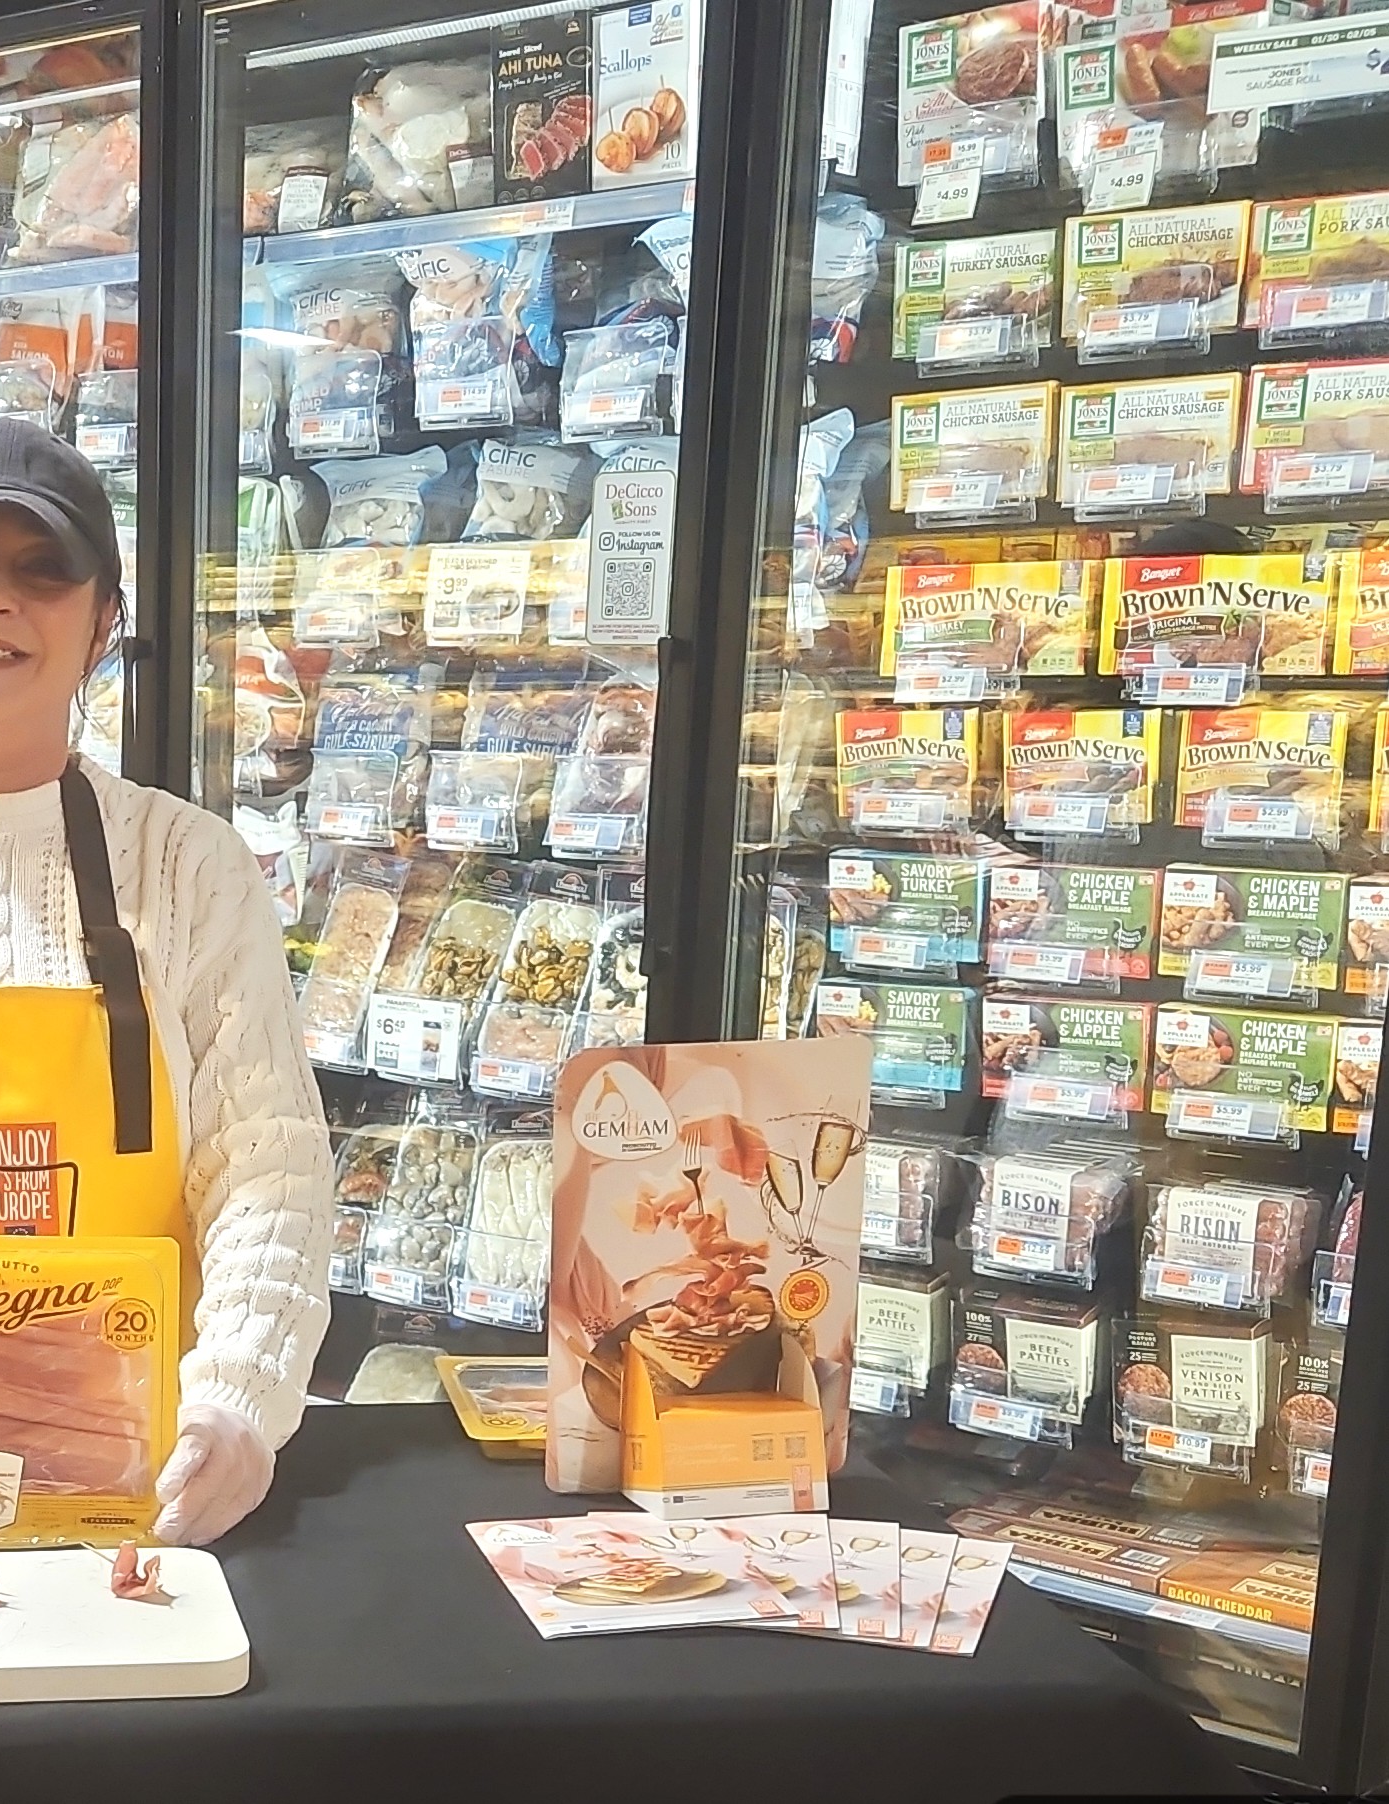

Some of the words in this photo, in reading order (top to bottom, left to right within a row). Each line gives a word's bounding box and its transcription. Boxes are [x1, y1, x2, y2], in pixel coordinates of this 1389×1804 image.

[914, 43, 949, 60] JONES
[1233, 42, 1273, 54] WEEKLY
[1274, 38, 1299, 49] SALE
[498, 61, 522, 77] AHI
[525, 53, 563, 73] TUNA
[600, 50, 652, 75] Scallops
[1071, 65, 1107, 82] JONES
[1269, 67, 1301, 79] JONES
[1246, 78, 1293, 92] SAUSAGE
[1296, 75, 1321, 85] ROLL
[665, 142, 681, 159] 10
[1111, 174, 1144, 188] $4.99
[937, 188, 969, 200] $4.99
[1321, 209, 1347, 221] ALL
[1129, 224, 1151, 236] ALL
[1155, 218, 1214, 233] NATURAL
[1272, 220, 1307, 233] JONES
[1318, 220, 1360, 235] PORK
[1085, 233, 1116, 247] JONES
[1128, 233, 1179, 249] CHICKEN
[1182, 228, 1234, 243] SAUSAGE
[975, 244, 1029, 259] NATURAL
[911, 258, 941, 270] JONES
[950, 259, 993, 273] TURKEY
[995, 253, 1048, 269] SAUSAGE
[1123, 313, 1150, 323] $3.79
[1316, 378, 1340, 391] ALL
[1122, 396, 1143, 408] ALL
[1147, 391, 1202, 406] NATURAL
[1266, 388, 1300, 401] JONES
[1314, 390, 1352, 403] PORK
[946, 405, 966, 417] ALL
[968, 400, 1018, 414] NATURAL
[1077, 407, 1108, 419] JONES
[1118, 405, 1169, 420] CHICKEN
[1172, 401, 1225, 415] SAUSAGE
[906, 416, 934, 428] JONES
[943, 413, 989, 428] CHICKEN
[992, 410, 1040, 423] SAUSAGE
[1314, 464, 1342, 474] $3.79
[606, 482, 663, 501] DeCicco
[625, 502, 657, 517] Sons
[616, 539, 664, 555] Instagram
[1140, 566, 1184, 583] Banquet
[1003, 587, 1069, 619] Serve
[1238, 582, 1310, 615] Serve
[1147, 616, 1200, 632] ORIGINAL
[1193, 676, 1220, 685] $2.99
[500, 723, 525, 737] WILD
[917, 738, 965, 761] Serve
[1091, 739, 1145, 764] Serve
[1274, 741, 1331, 767] Serve
[1261, 809, 1289, 817] $2.99
[901, 863, 953, 880] SAVORY
[901, 877, 955, 894] TURKEY
[995, 885, 1033, 893] APPLEGATE
[1070, 871, 1135, 892] CHICKEN
[1250, 877, 1321, 897] CHICKEN
[1068, 891, 1078, 904] &
[1084, 891, 1129, 906] APPLE
[1248, 898, 1258, 911] &
[1262, 897, 1319, 913] MAPLE
[1247, 909, 1284, 918] BREAKFAST
[1286, 911, 1317, 921] SAUSAGE
[1235, 963, 1262, 974] $5.99
[888, 990, 941, 1007] SAVORY
[887, 1004, 941, 1021] TURKEY
[1060, 1008, 1123, 1026] CHICKEN
[1060, 1024, 1067, 1037] &
[1071, 1024, 1120, 1040] APPLE
[1242, 1019, 1307, 1040] CHICKEN
[1240, 1039, 1251, 1052] &
[1255, 1039, 1306, 1057] MAPLE
[1240, 1051, 1277, 1061] BREAKFAST
[1216, 1107, 1243, 1116] $5.99
[583, 1119, 668, 1138] GEMHAM
[15, 1170, 50, 1192] FROM
[1000, 1188, 1061, 1215] BISON
[1177, 1198, 1209, 1209] FORCE
[1215, 1201, 1247, 1217] NATURE
[1180, 1213, 1242, 1243] BISON
[102, 1277, 123, 1292] DOP
[1190, 1275, 1221, 1286] $10.99
[113, 1311, 147, 1333] 20
[878, 1308, 907, 1321] BEEF
[965, 1311, 992, 1324] 100%
[868, 1315, 916, 1332] PATTIES
[106, 1333, 156, 1343] MONTHS
[1029, 1343, 1060, 1355] BEEF
[1129, 1352, 1142, 1362] 25
[1019, 1350, 1070, 1368] PATTIES
[1299, 1355, 1330, 1369] 100%
[1181, 1369, 1245, 1385] VENISON
[1183, 1387, 1242, 1401] PATTIES
[1297, 1380, 1310, 1392] 25
[1175, 1436, 1207, 1449] $10.99
[1167, 1585, 1211, 1607] BACON
[1213, 1597, 1274, 1623] CHEDDAR
